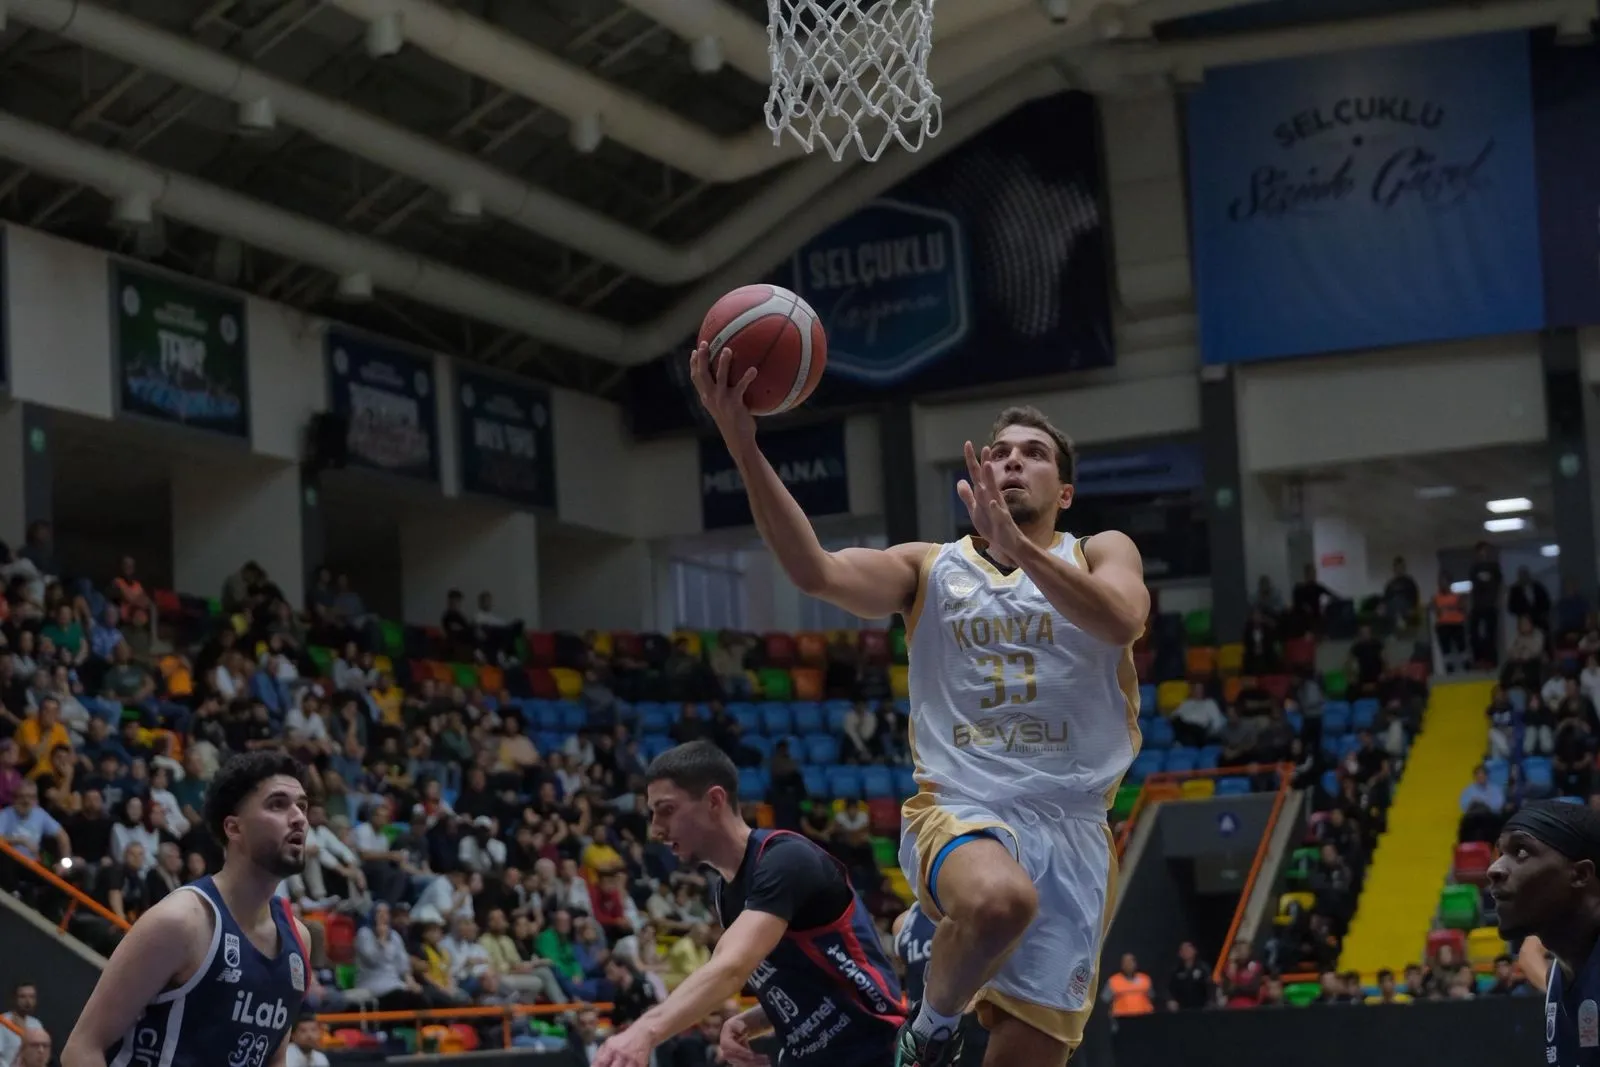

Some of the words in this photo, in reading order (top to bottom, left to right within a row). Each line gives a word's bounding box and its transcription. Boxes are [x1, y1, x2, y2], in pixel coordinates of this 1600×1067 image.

[808, 232, 947, 290] SELÇUKLU
[952, 612, 1054, 651] KONYA
[976, 652, 1038, 708] 33
[231, 989, 288, 1031] iLab
